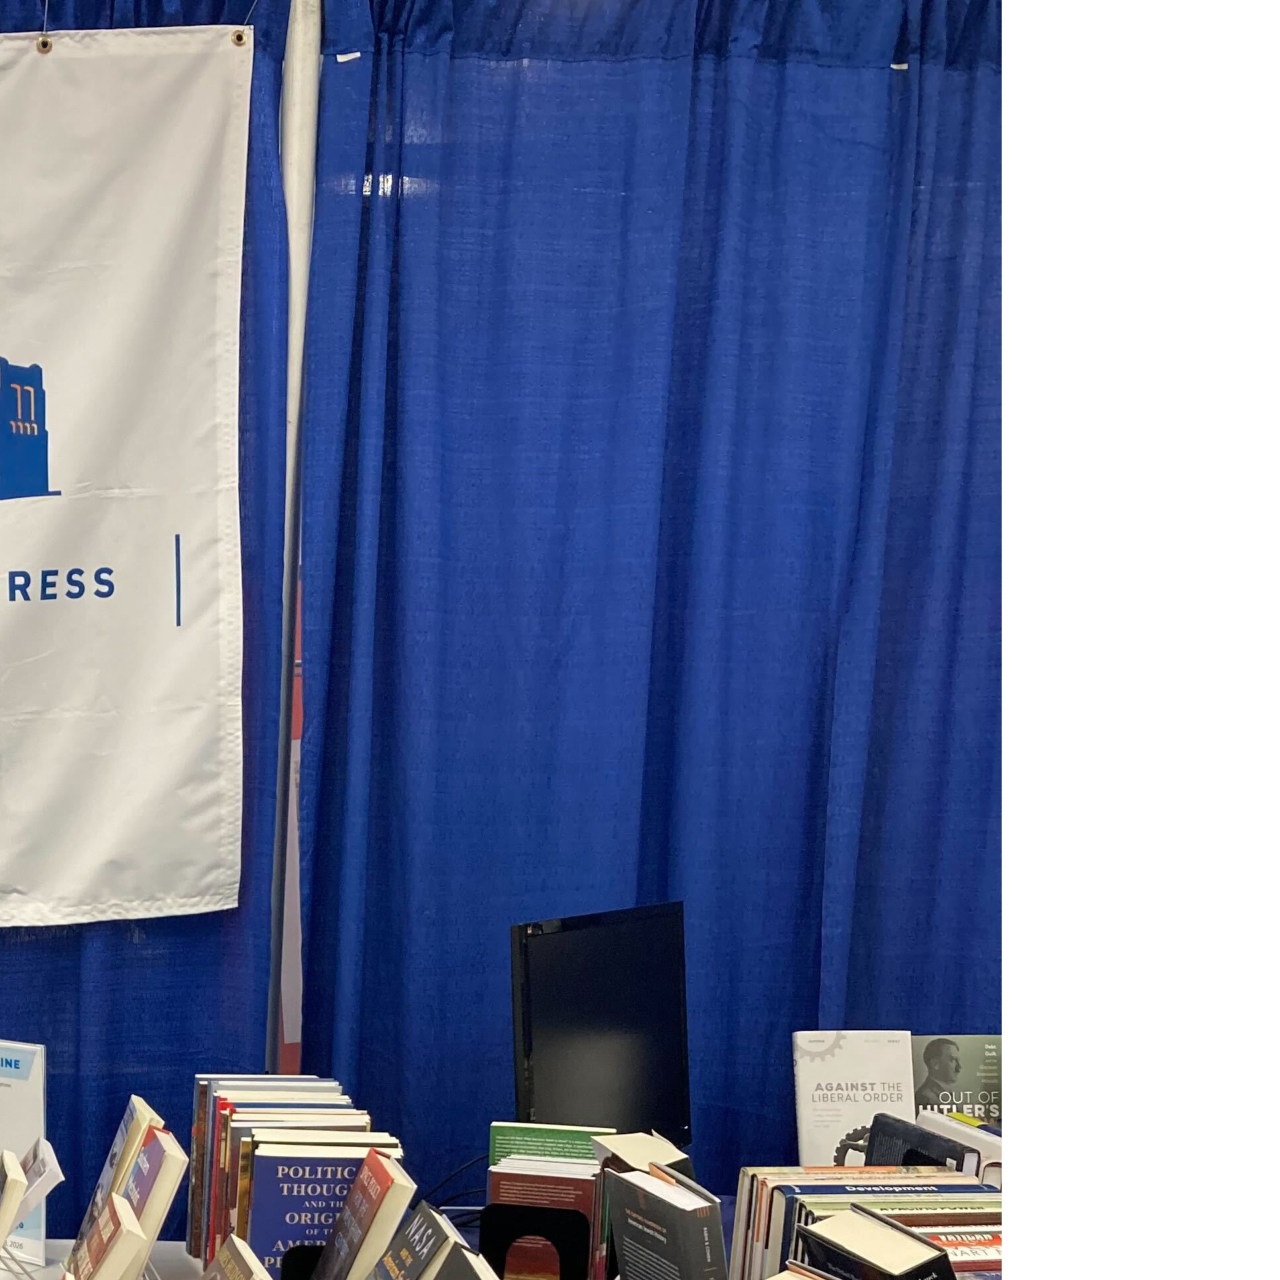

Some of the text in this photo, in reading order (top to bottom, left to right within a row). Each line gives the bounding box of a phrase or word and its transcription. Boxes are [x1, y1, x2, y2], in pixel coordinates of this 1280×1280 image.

[815, 1083, 902, 1091] AGAINST THE
[812, 1093, 903, 1102] LIBERAL ORDER
[939, 1091, 999, 1103] OUT OF
[277, 1166, 356, 1179] POLITIC
[280, 1184, 353, 1196] THOUG
[405, 1214, 436, 1260] NASA
[10, 1241, 23, 1249] 2026
